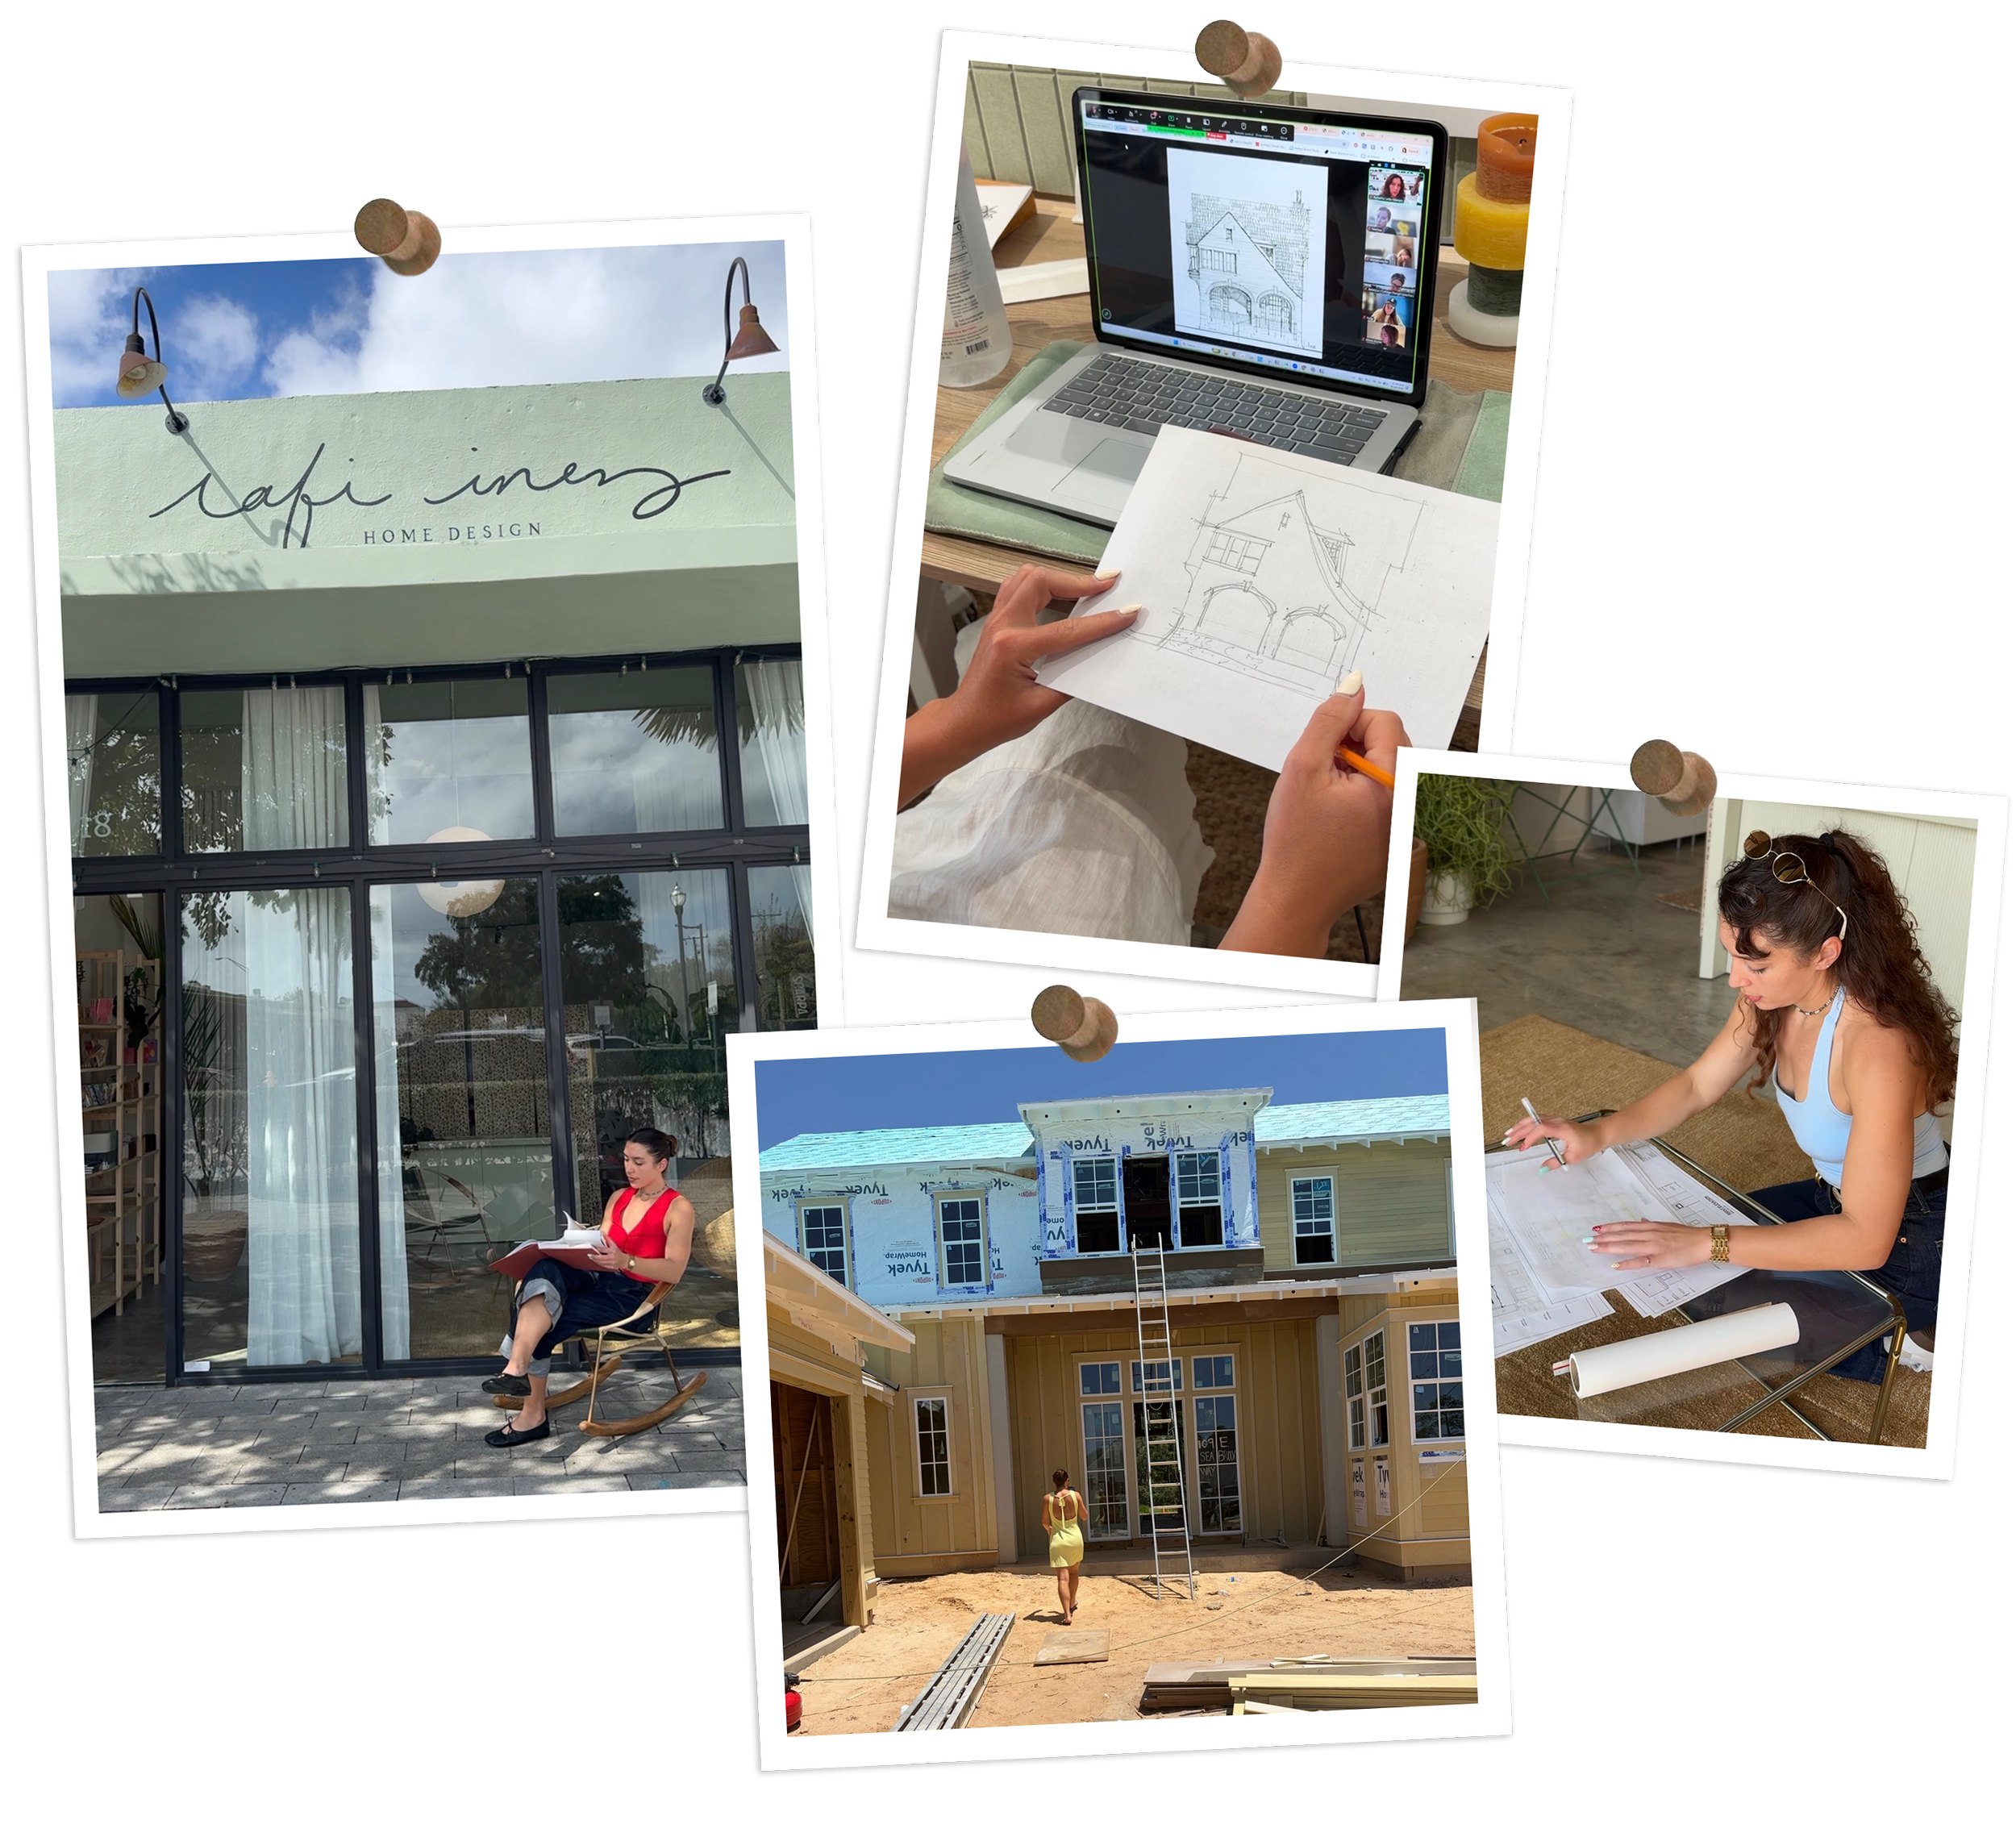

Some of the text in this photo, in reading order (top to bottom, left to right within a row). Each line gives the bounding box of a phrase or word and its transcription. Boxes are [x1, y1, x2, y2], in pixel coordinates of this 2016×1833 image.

[364, 523, 541, 544] HOME DESIGN
[884, 1251, 927, 1260] HomeWrap
[887, 1259, 931, 1277] Tyvek
[1198, 1437, 1214, 1449] 109
